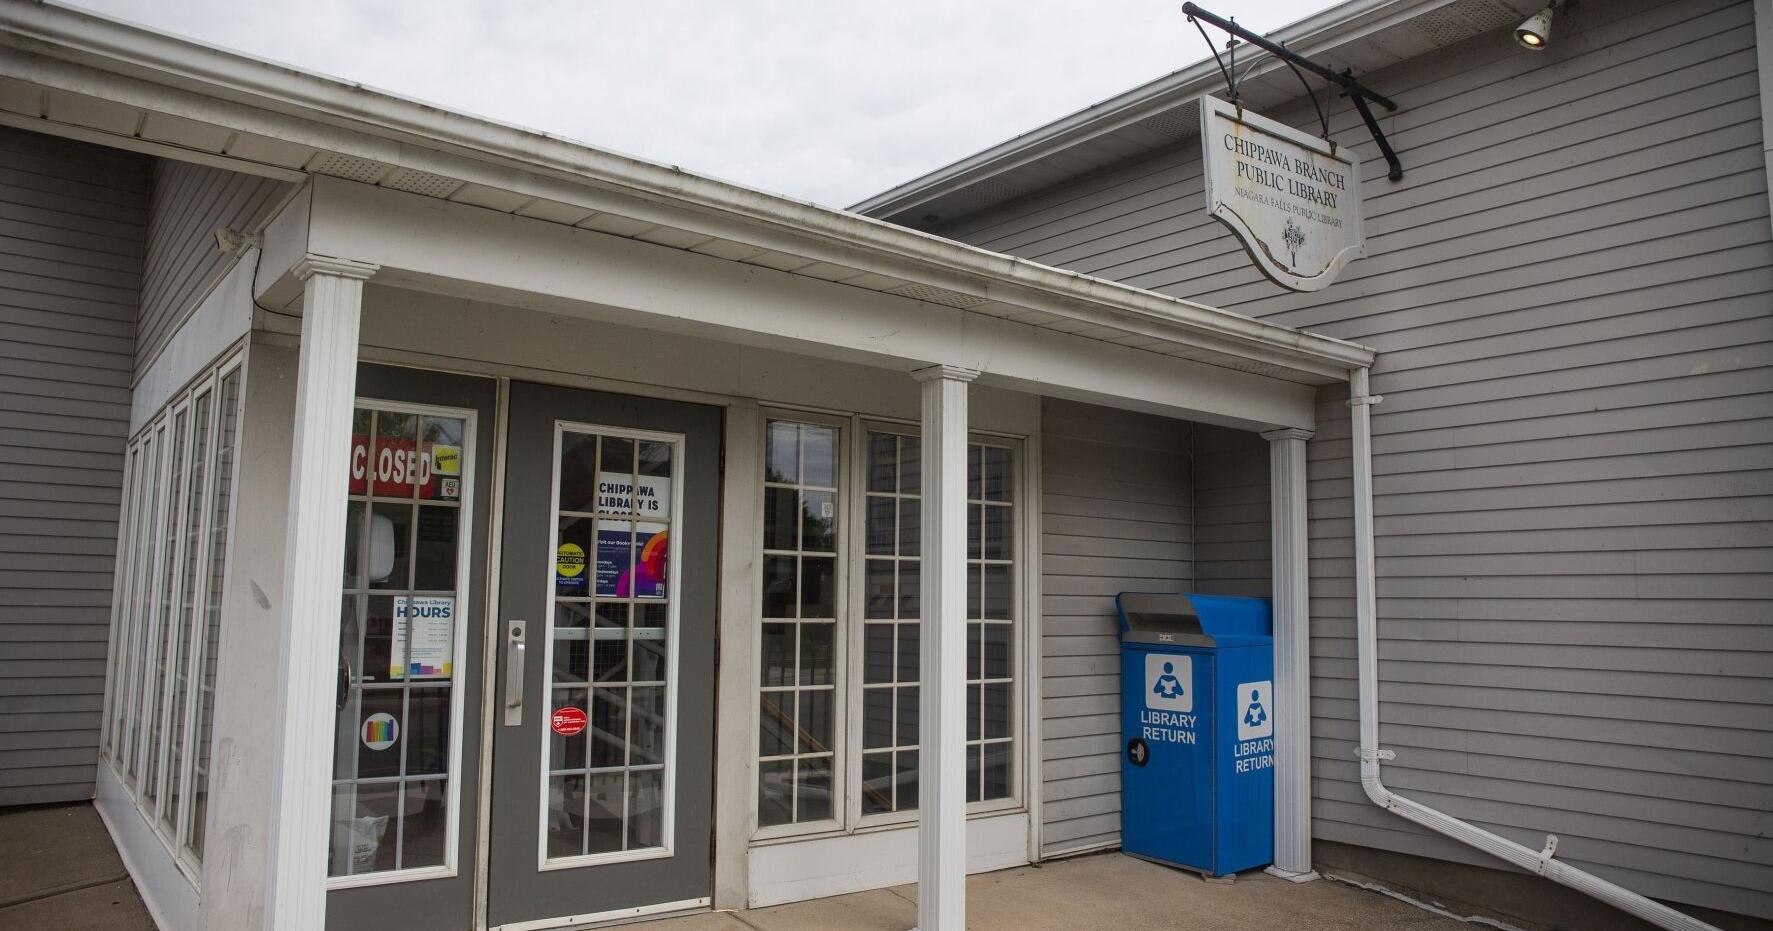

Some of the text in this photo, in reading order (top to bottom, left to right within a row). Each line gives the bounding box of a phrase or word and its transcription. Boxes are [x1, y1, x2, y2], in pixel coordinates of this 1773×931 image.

[1224, 134, 1345, 190] CHIPPAWA BRANCH
[1237, 161, 1338, 208] PUBLIC LIBRARY
[1234, 186, 1343, 229] NIAGARA FALLS PUBLIC LIBRARY
[352, 444, 431, 486] COSED
[435, 454, 458, 462] Interac
[599, 482, 655, 497] CHIPPWA
[598, 496, 659, 511] LIBRAY IS
[396, 606, 451, 618] HOURS
[1140, 710, 1197, 729] LIBRARY
[1142, 726, 1196, 745] RETURN
[1234, 738, 1274, 757] LIBRARY
[1236, 755, 1274, 774] RETURN
